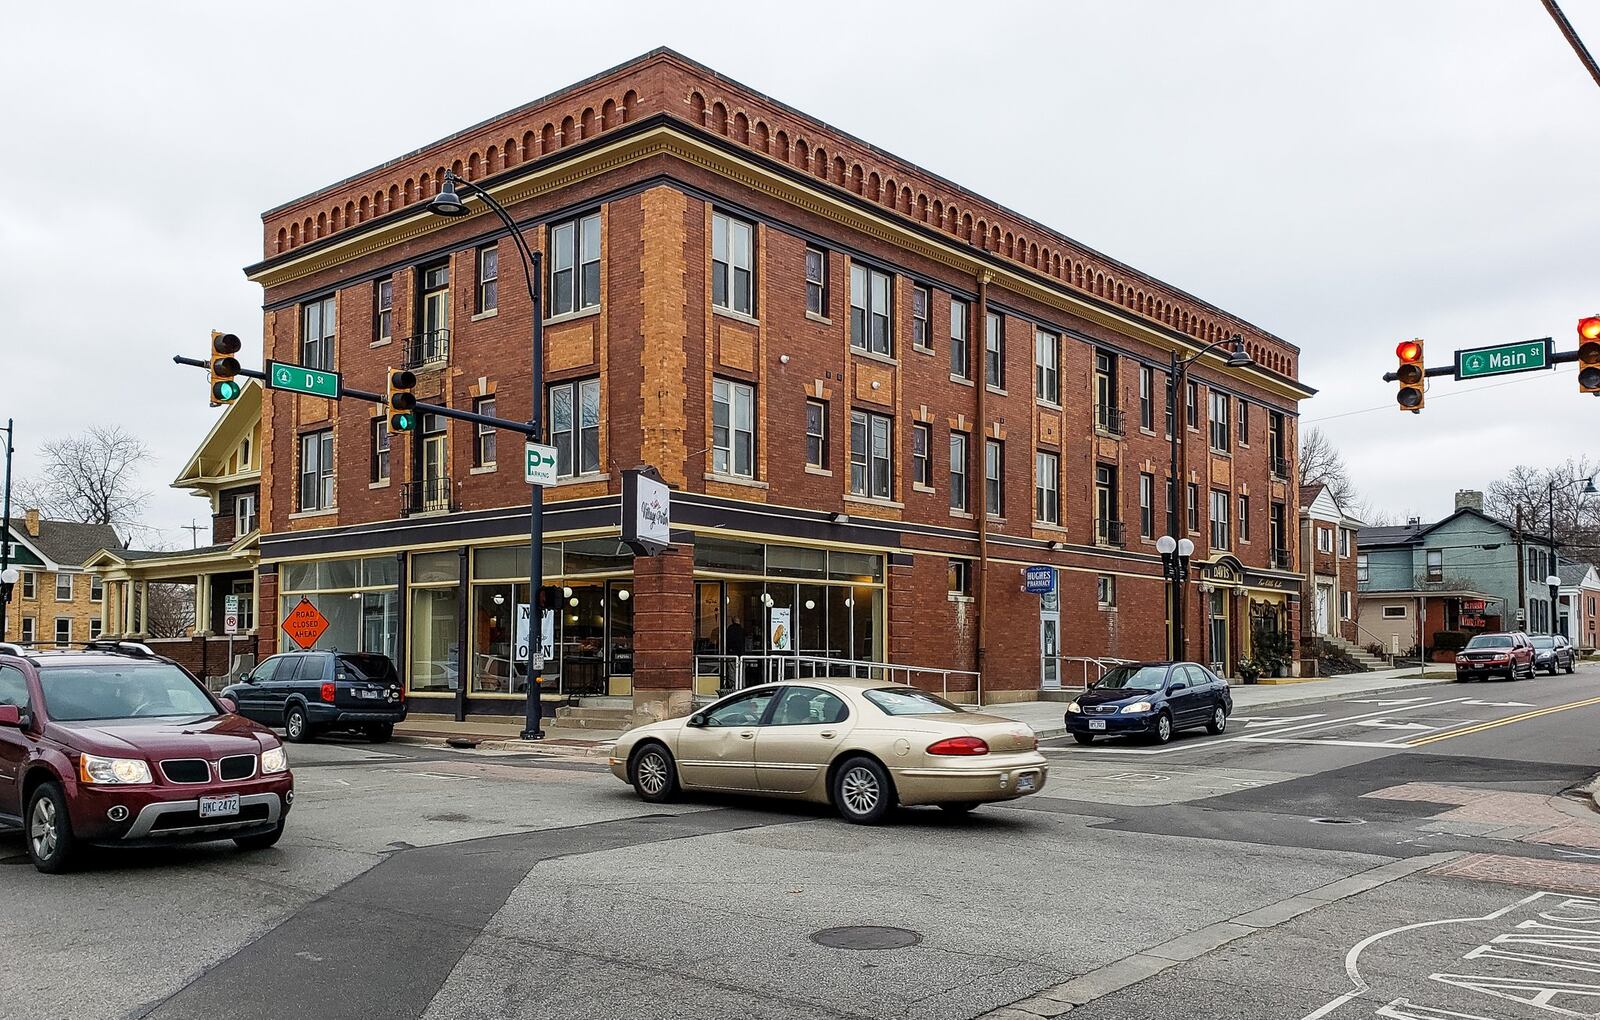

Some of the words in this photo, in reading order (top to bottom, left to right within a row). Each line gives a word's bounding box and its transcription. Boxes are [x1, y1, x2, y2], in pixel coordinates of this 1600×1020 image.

[1489, 351, 1526, 369] Main
[1530, 347, 1540, 357] St
[305, 374, 314, 388] D
[316, 376, 324, 385] St
[1027, 571, 1051, 581] HUGHES
[1213, 565, 1230, 578] DAVIS
[1027, 579, 1051, 588] PHARMACY
[296, 610, 315, 619] ROAD
[292, 620, 319, 629] CLOSED
[294, 630, 318, 639] AHEAD
[202, 802, 217, 813] HKC
[218, 799, 238, 812] 2472
